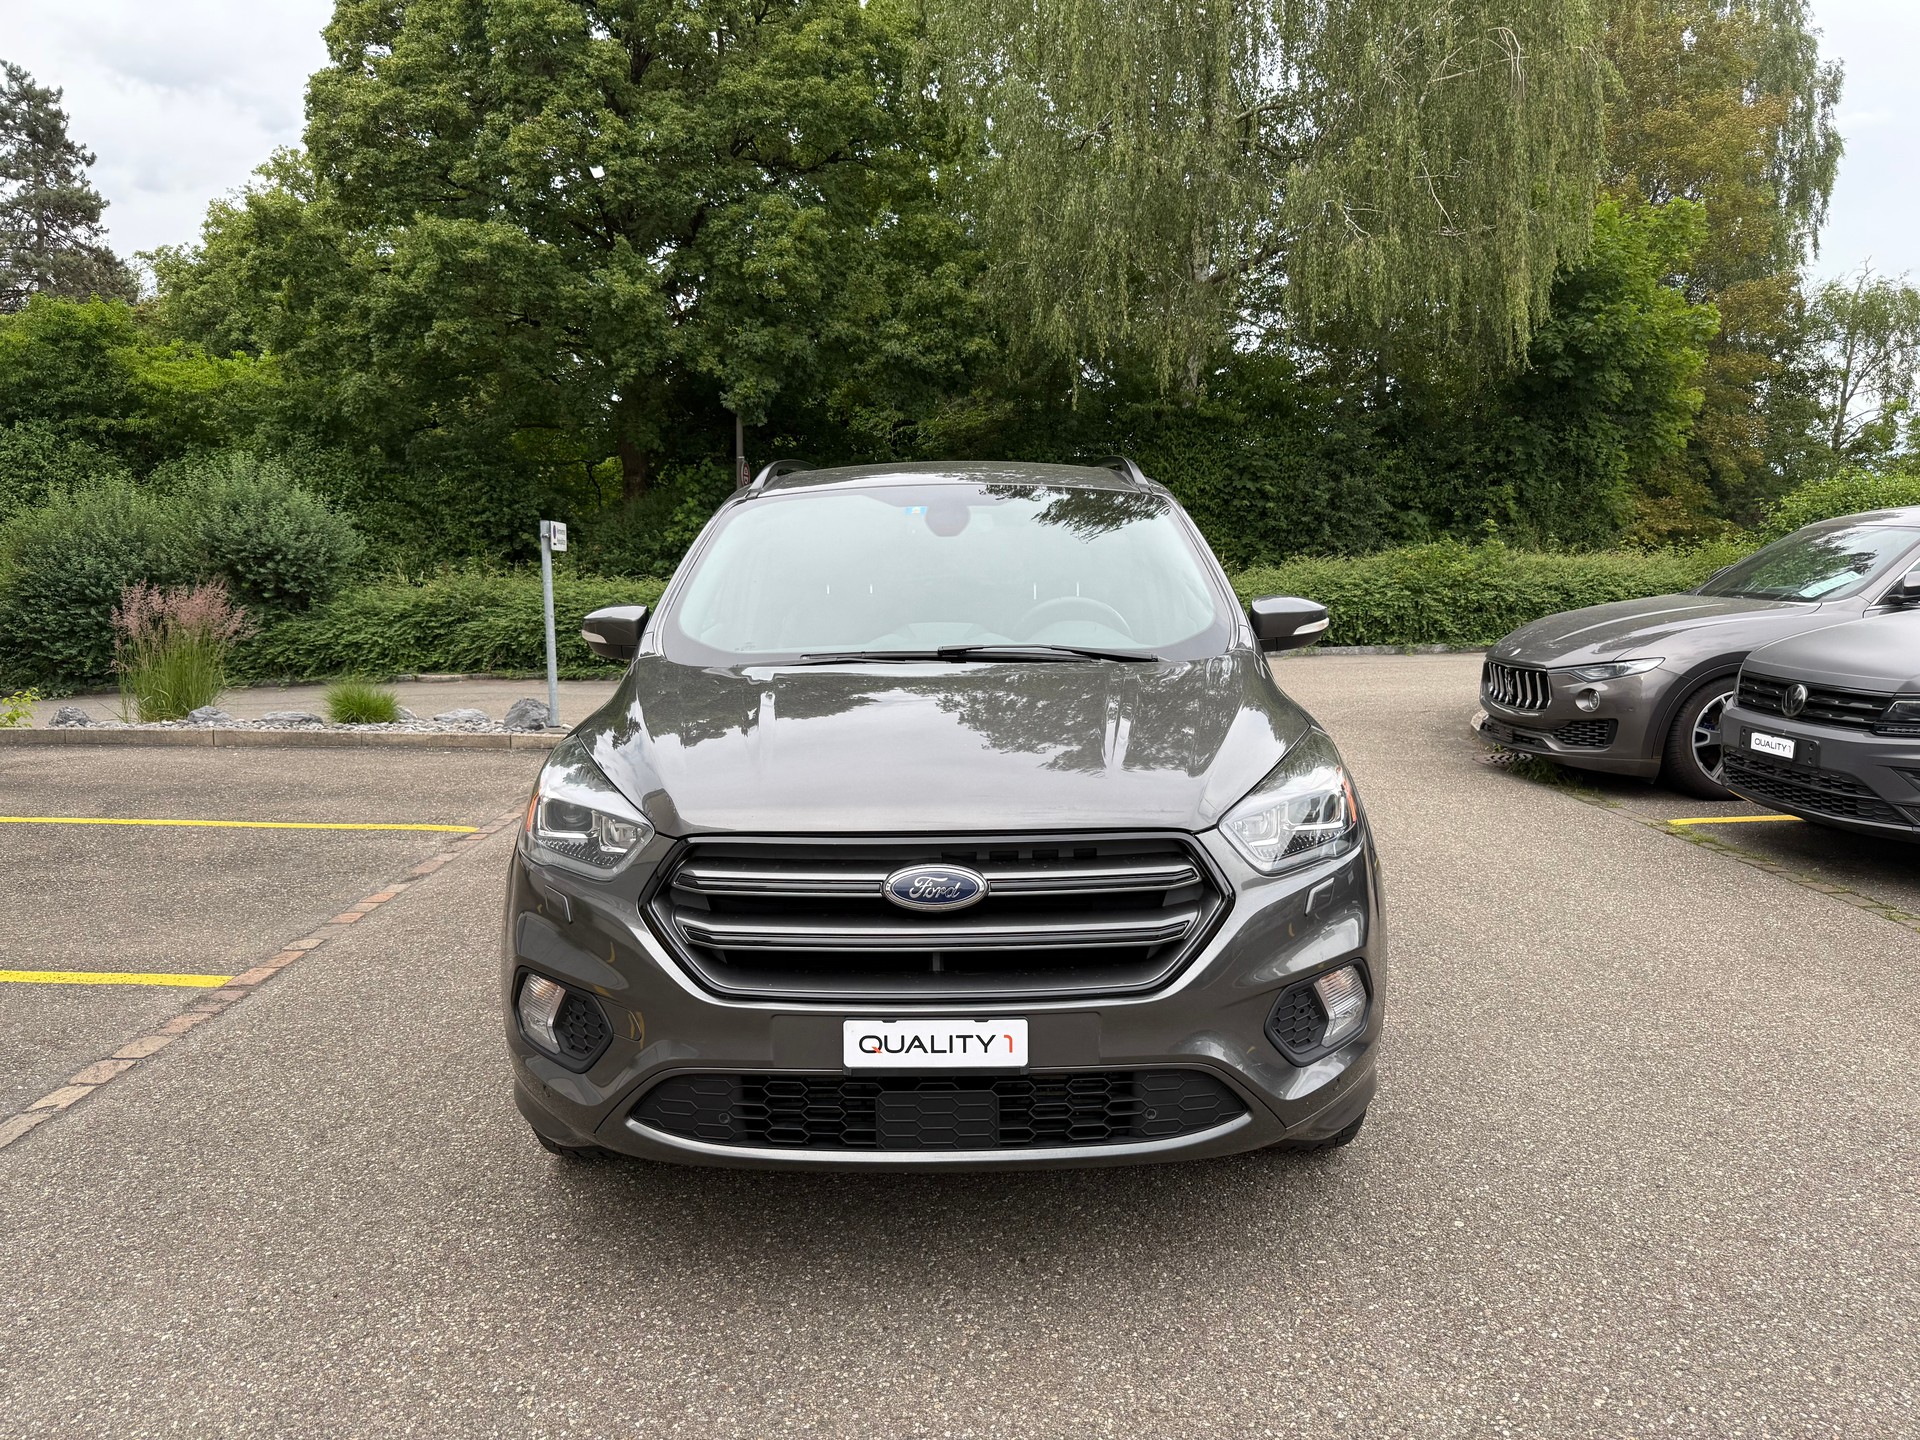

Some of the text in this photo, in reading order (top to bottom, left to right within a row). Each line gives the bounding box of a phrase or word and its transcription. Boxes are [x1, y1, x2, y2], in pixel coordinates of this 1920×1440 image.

[909, 876, 961, 899] Ford
[858, 1034, 1014, 1054] QUALITY 1
